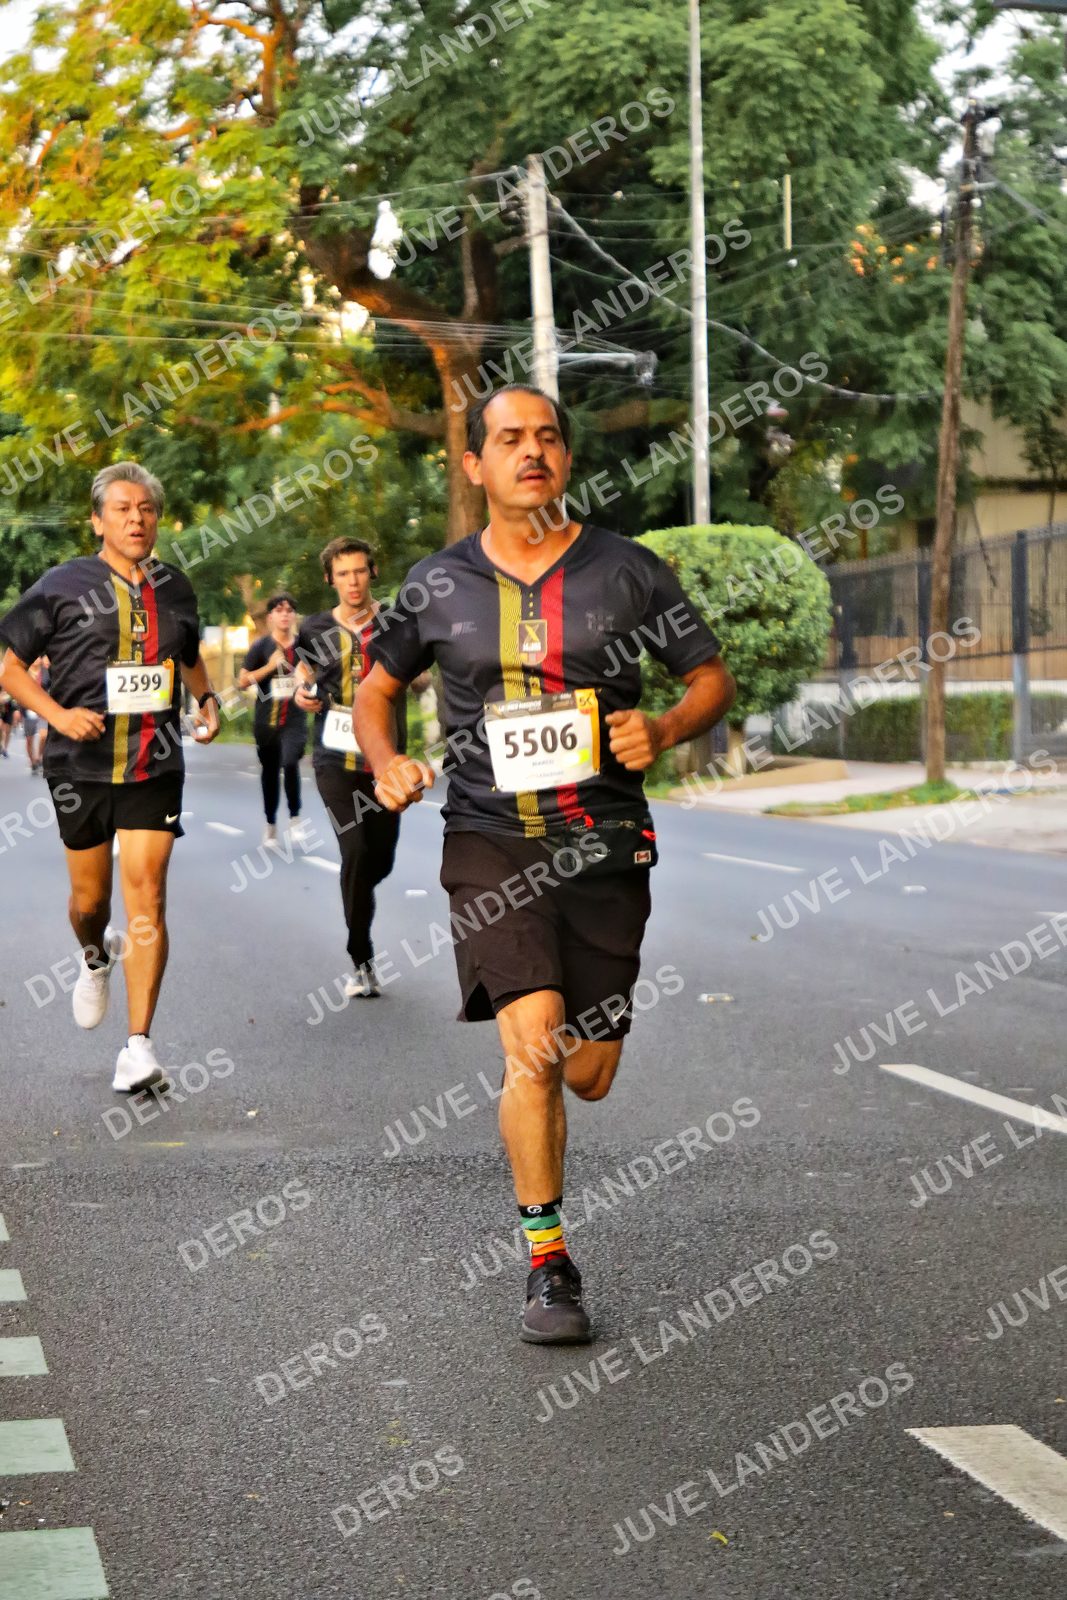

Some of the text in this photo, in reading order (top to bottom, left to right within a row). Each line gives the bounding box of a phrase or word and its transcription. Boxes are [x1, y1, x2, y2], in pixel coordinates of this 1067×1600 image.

[117, 673, 162, 693] 2599
[335, 718, 354, 734] 16
[504, 722, 578, 759] 5506
